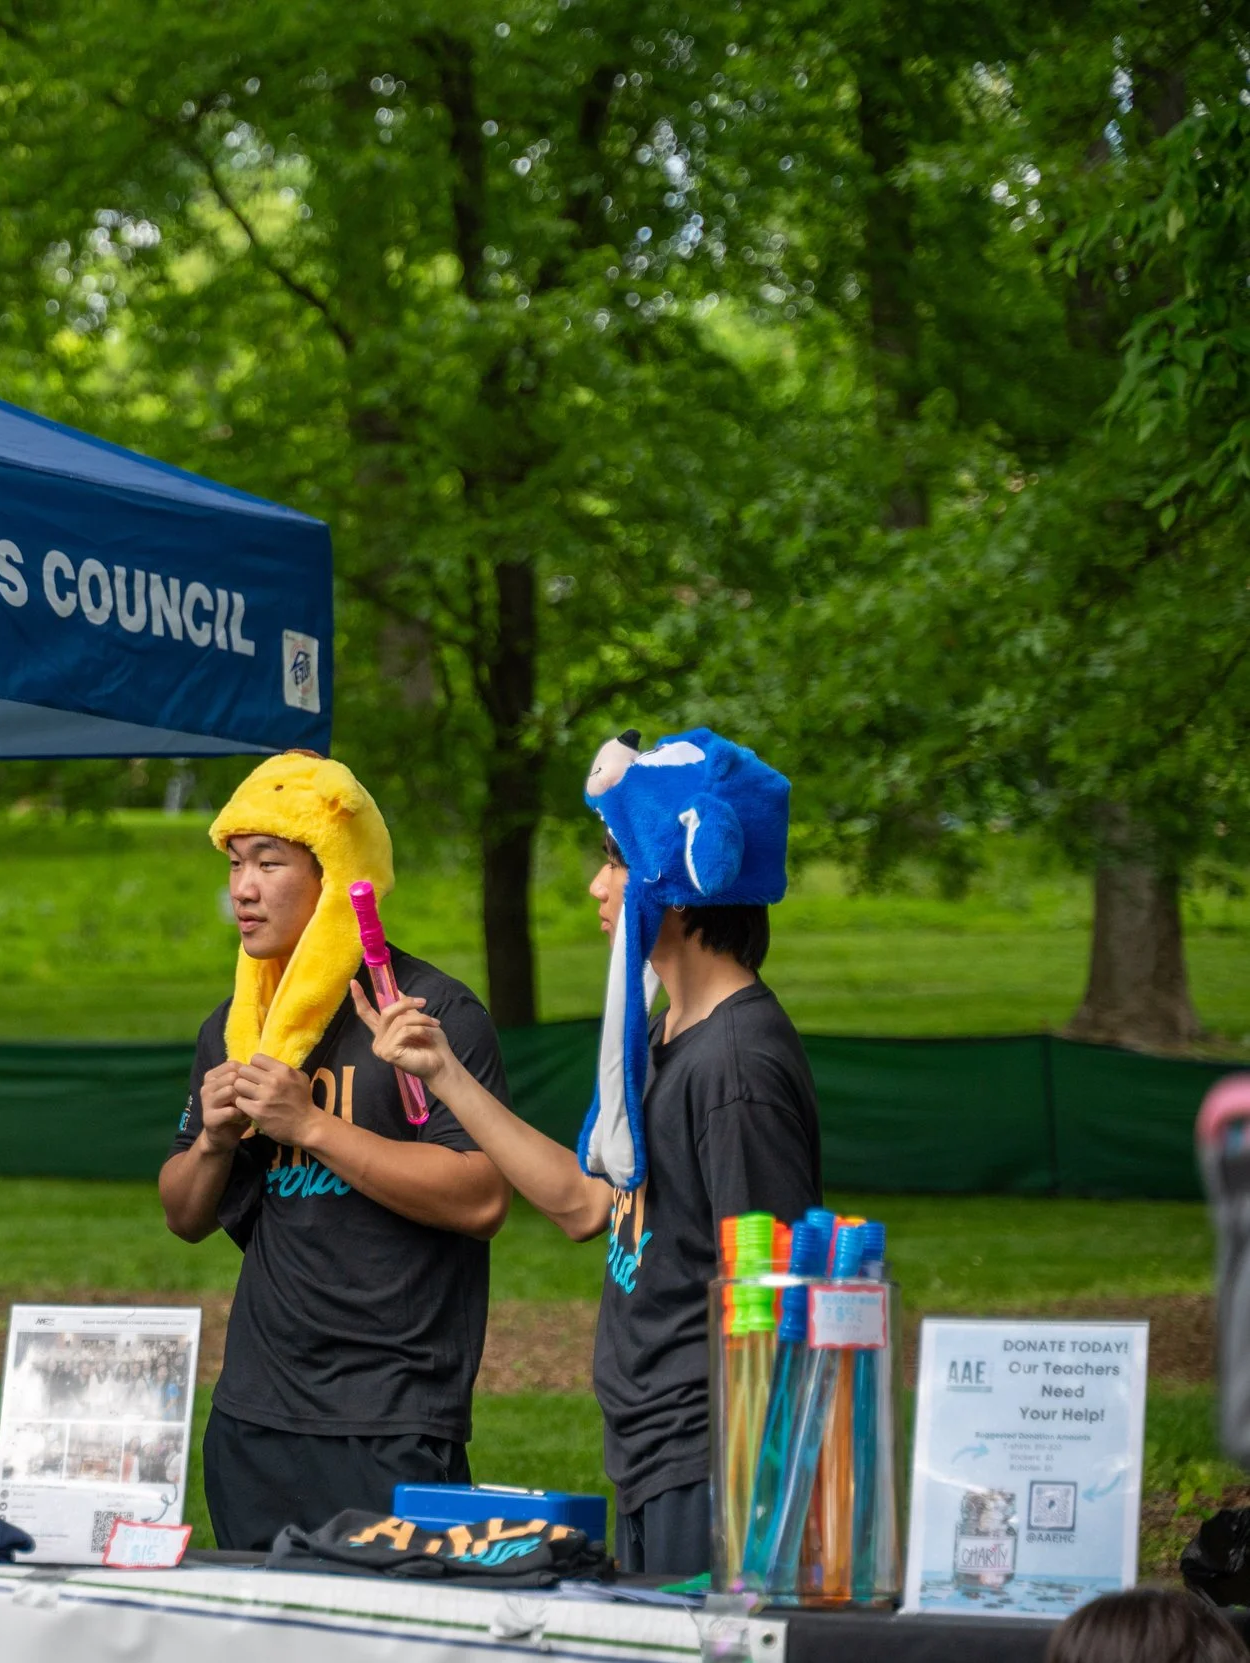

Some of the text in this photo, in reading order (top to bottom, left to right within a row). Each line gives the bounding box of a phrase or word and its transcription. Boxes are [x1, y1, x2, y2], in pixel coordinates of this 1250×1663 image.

[42, 550, 255, 656] COUNCIL
[1003, 1339, 1129, 1354] DONATE TODAY!
[948, 1360, 987, 1385] AAE
[1008, 1361, 1120, 1376] Our Teachers
[1041, 1384, 1085, 1398] Need
[1019, 1406, 1105, 1424] Your Help!
[1025, 1532, 1075, 1544] @AAEHC
